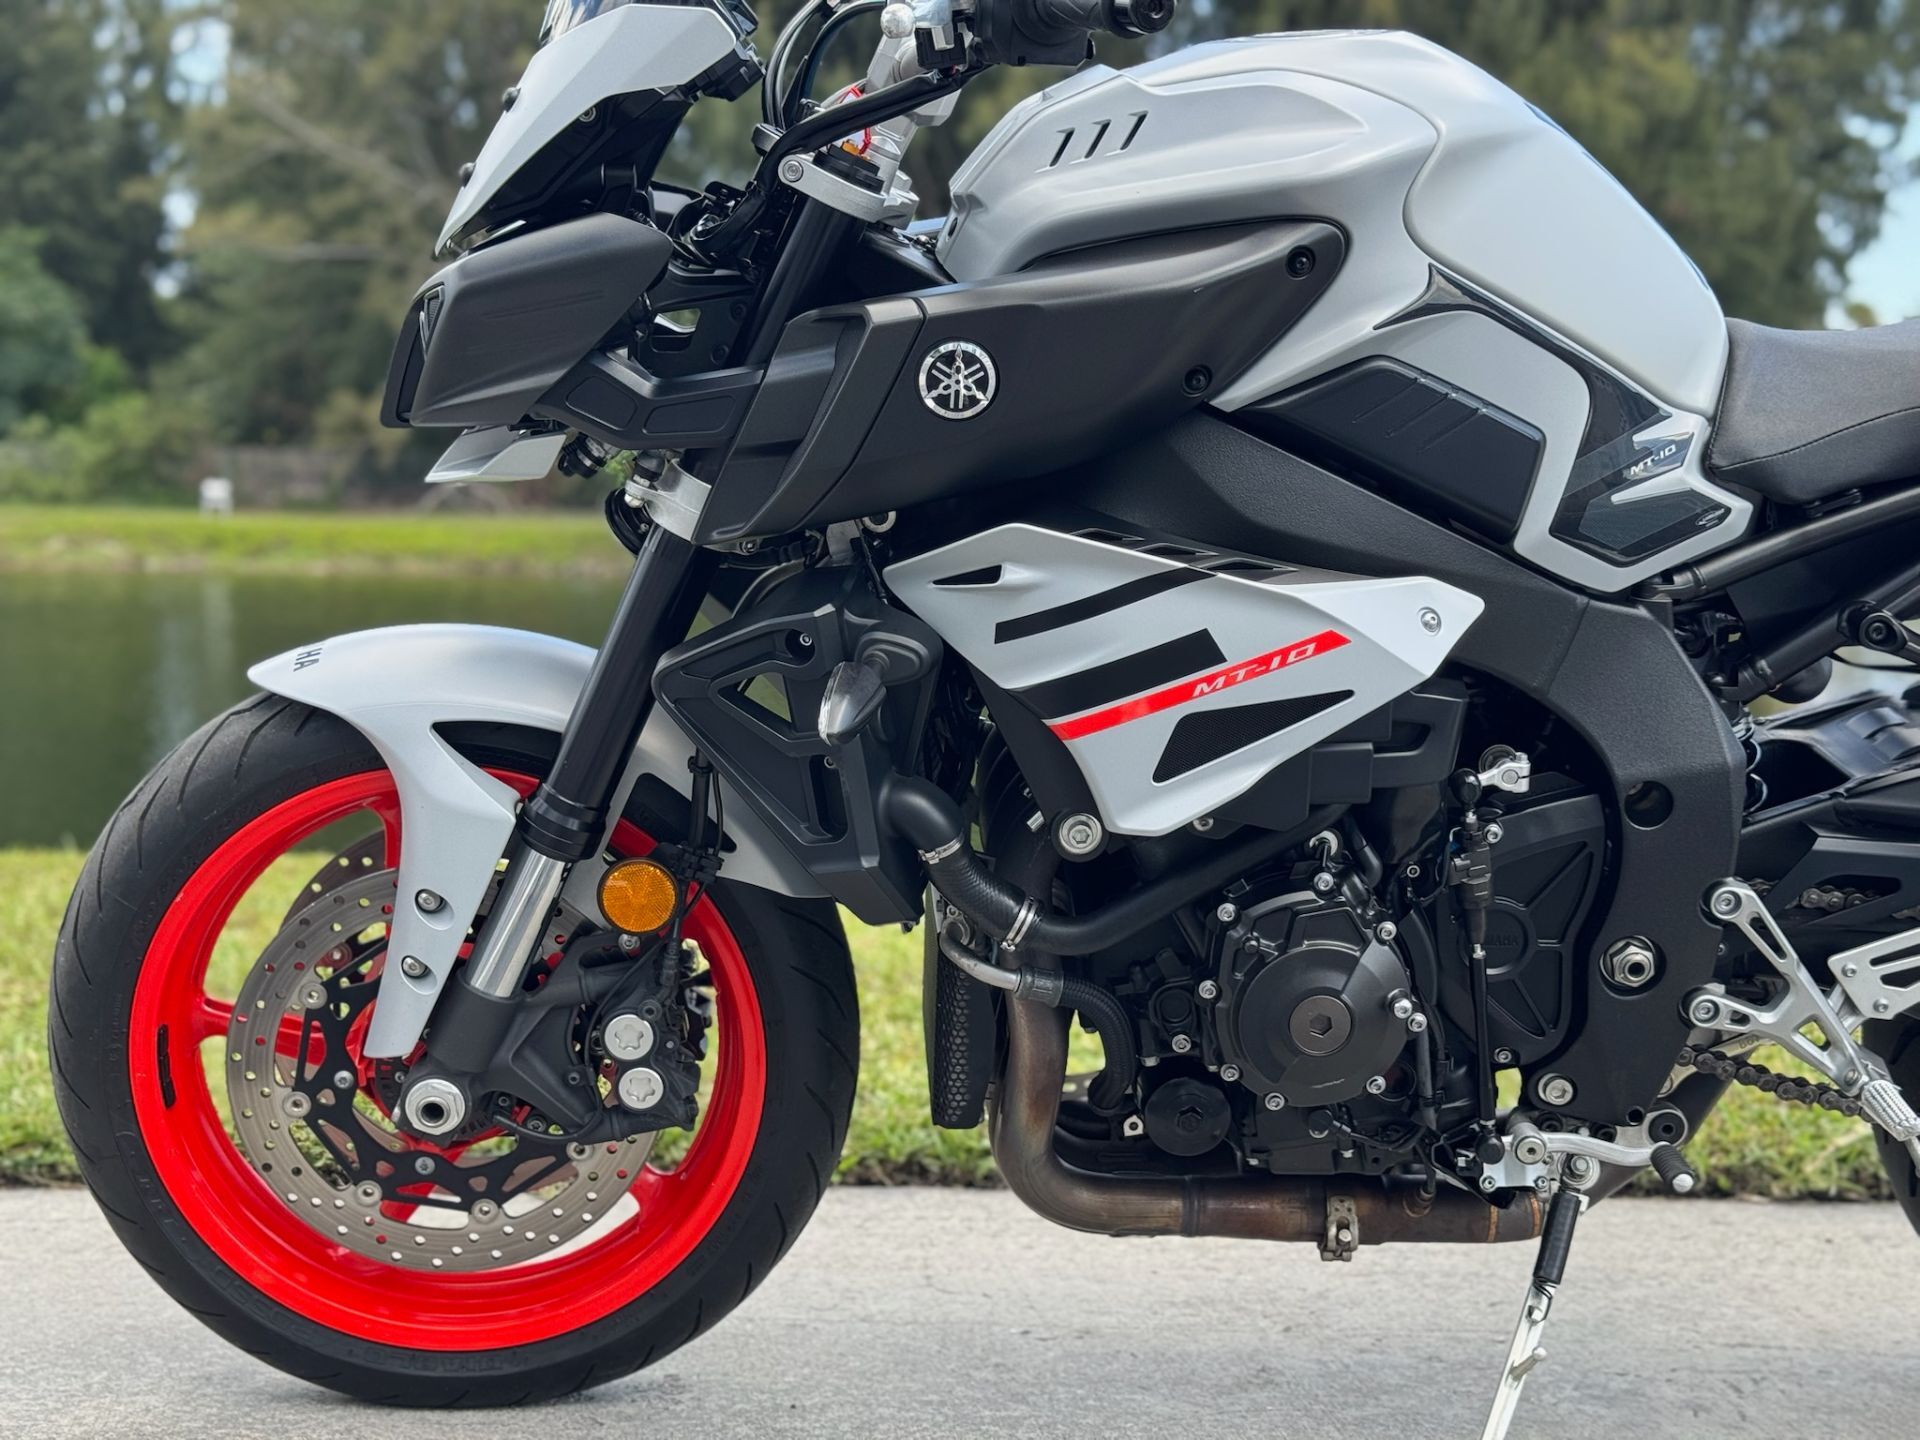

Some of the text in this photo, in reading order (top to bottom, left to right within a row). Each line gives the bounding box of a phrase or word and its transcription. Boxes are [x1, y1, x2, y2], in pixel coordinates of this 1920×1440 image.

[1630, 443, 1677, 476] MT-10
[293, 644, 323, 673] HA
[1191, 641, 1317, 698] MT-10
